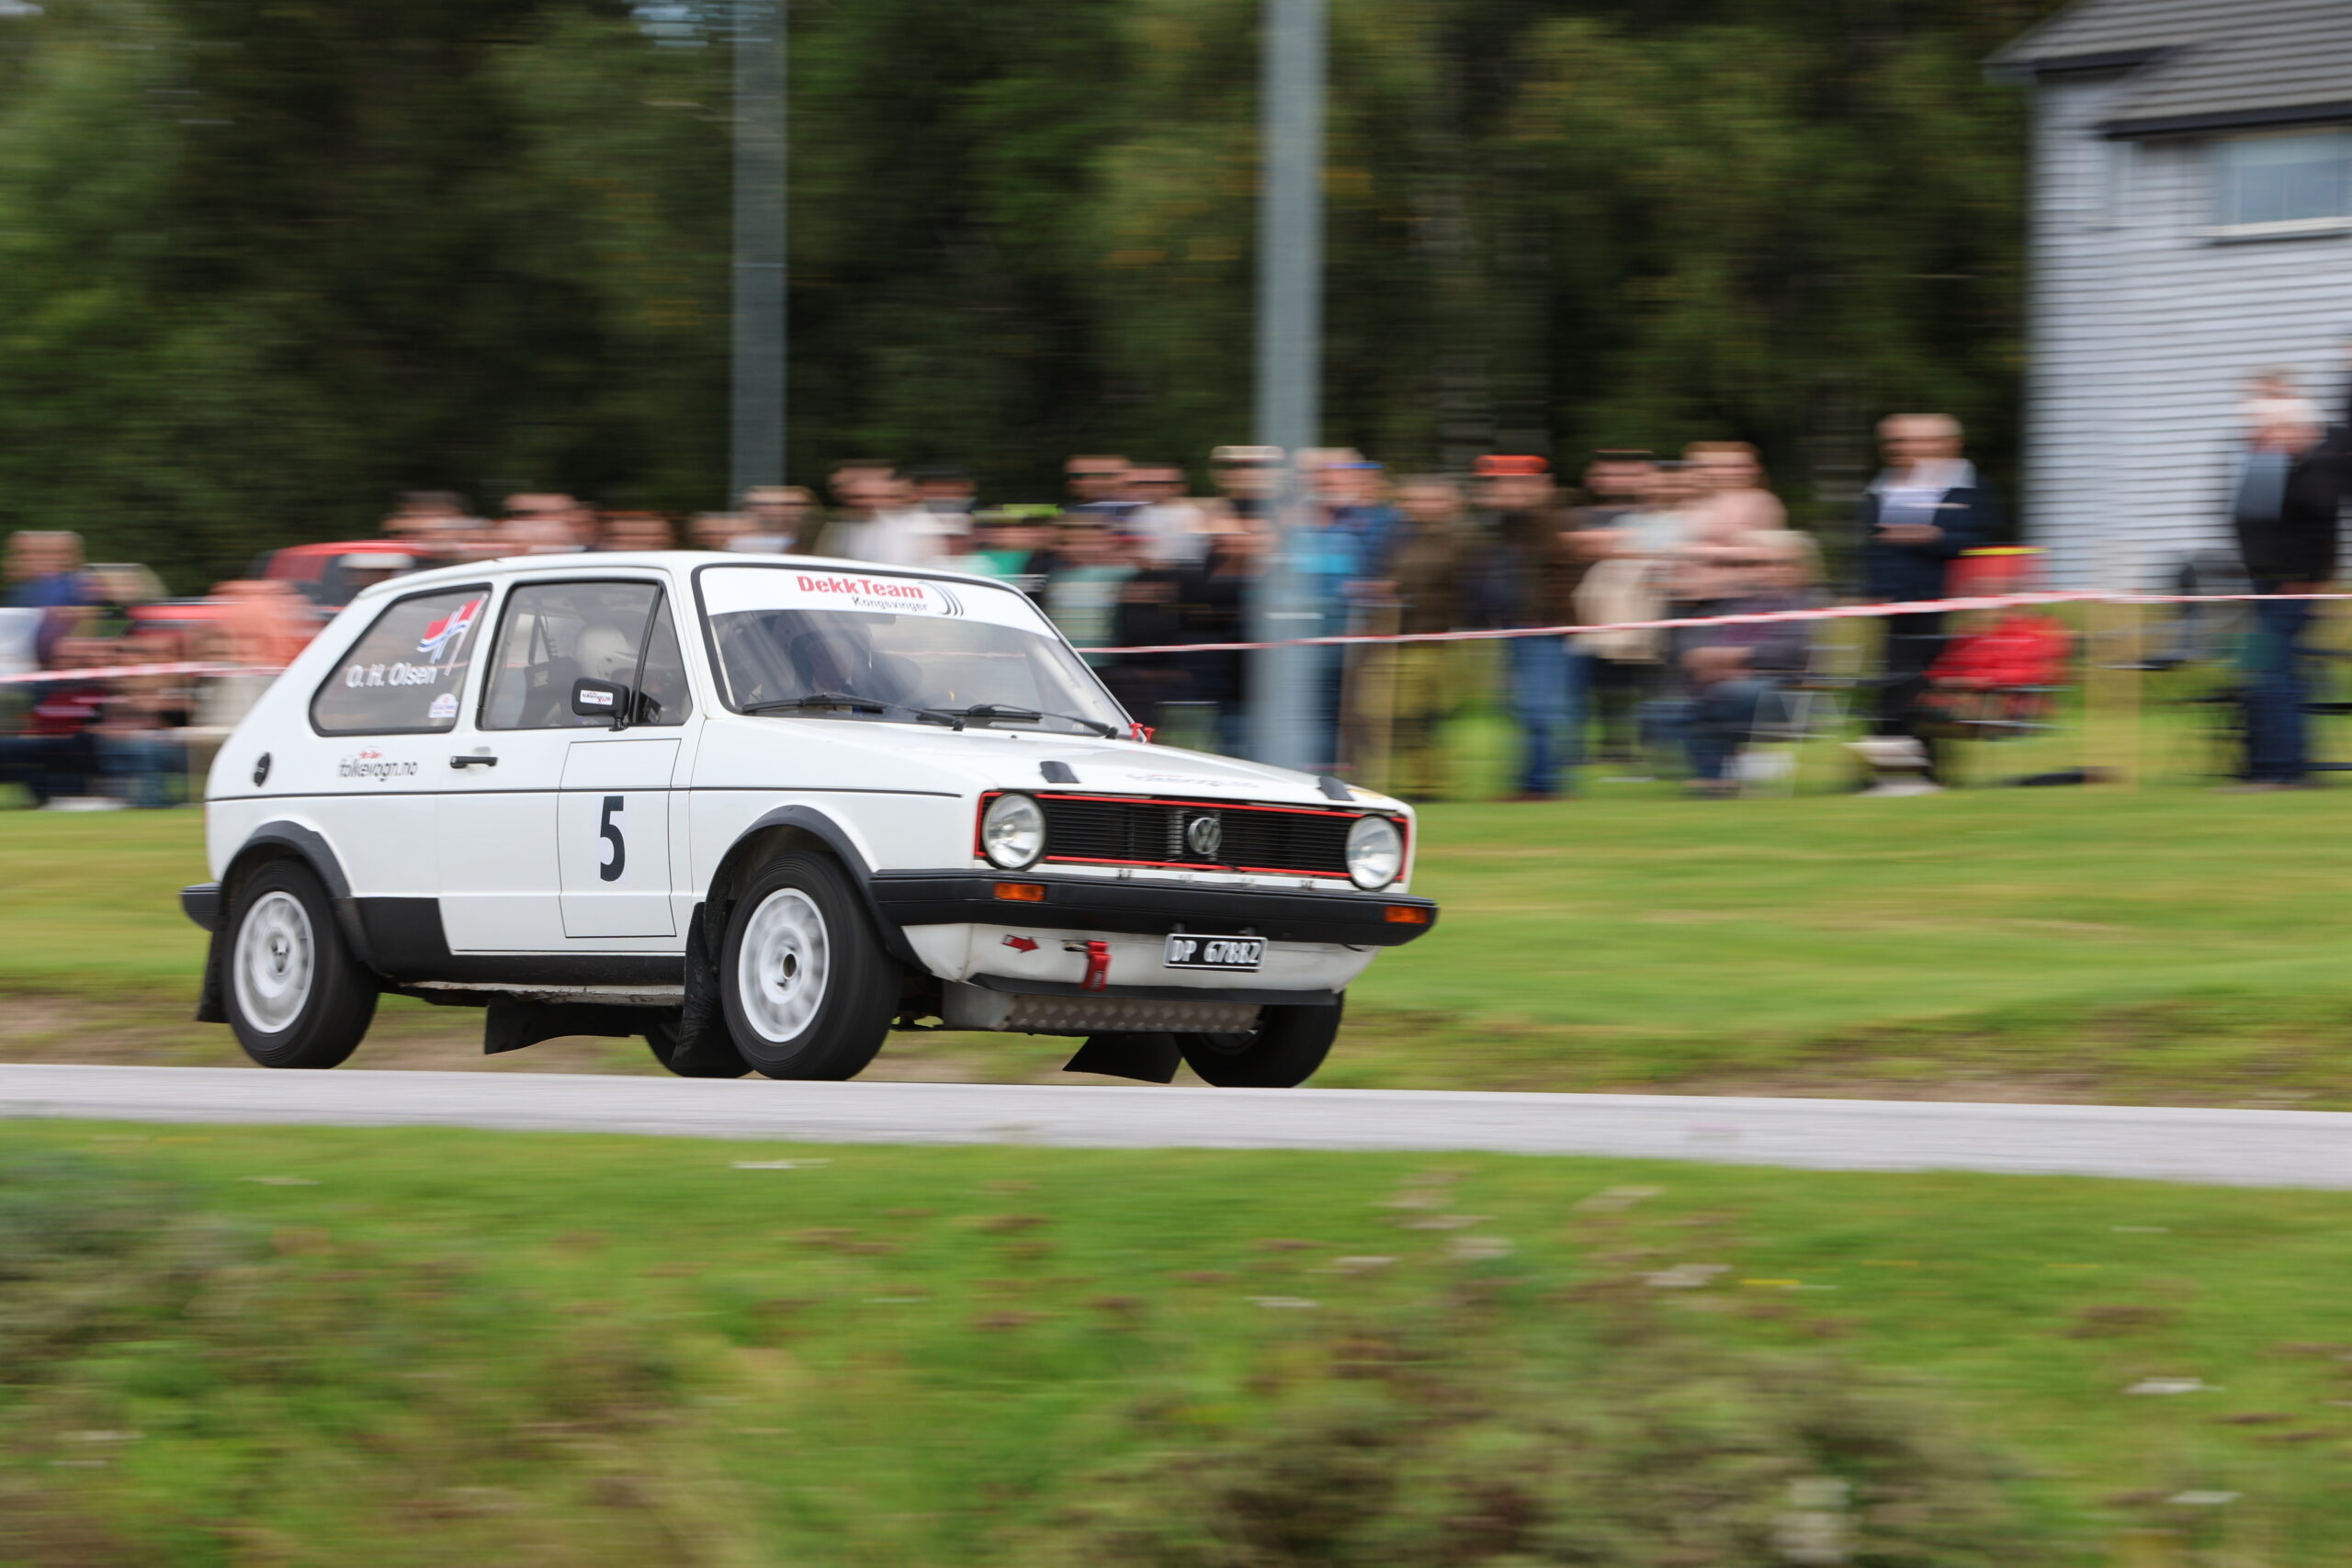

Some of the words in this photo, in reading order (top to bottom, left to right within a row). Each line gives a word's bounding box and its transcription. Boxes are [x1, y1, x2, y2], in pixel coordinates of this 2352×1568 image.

[852, 596, 928, 612] Kongsvinger
[345, 664, 364, 688] O.
[366, 663, 385, 687] H.
[388, 662, 437, 686] Olsen
[600, 795, 625, 882] 5
[1170, 940, 1197, 962] DP
[1204, 941, 1261, 964] 67882
